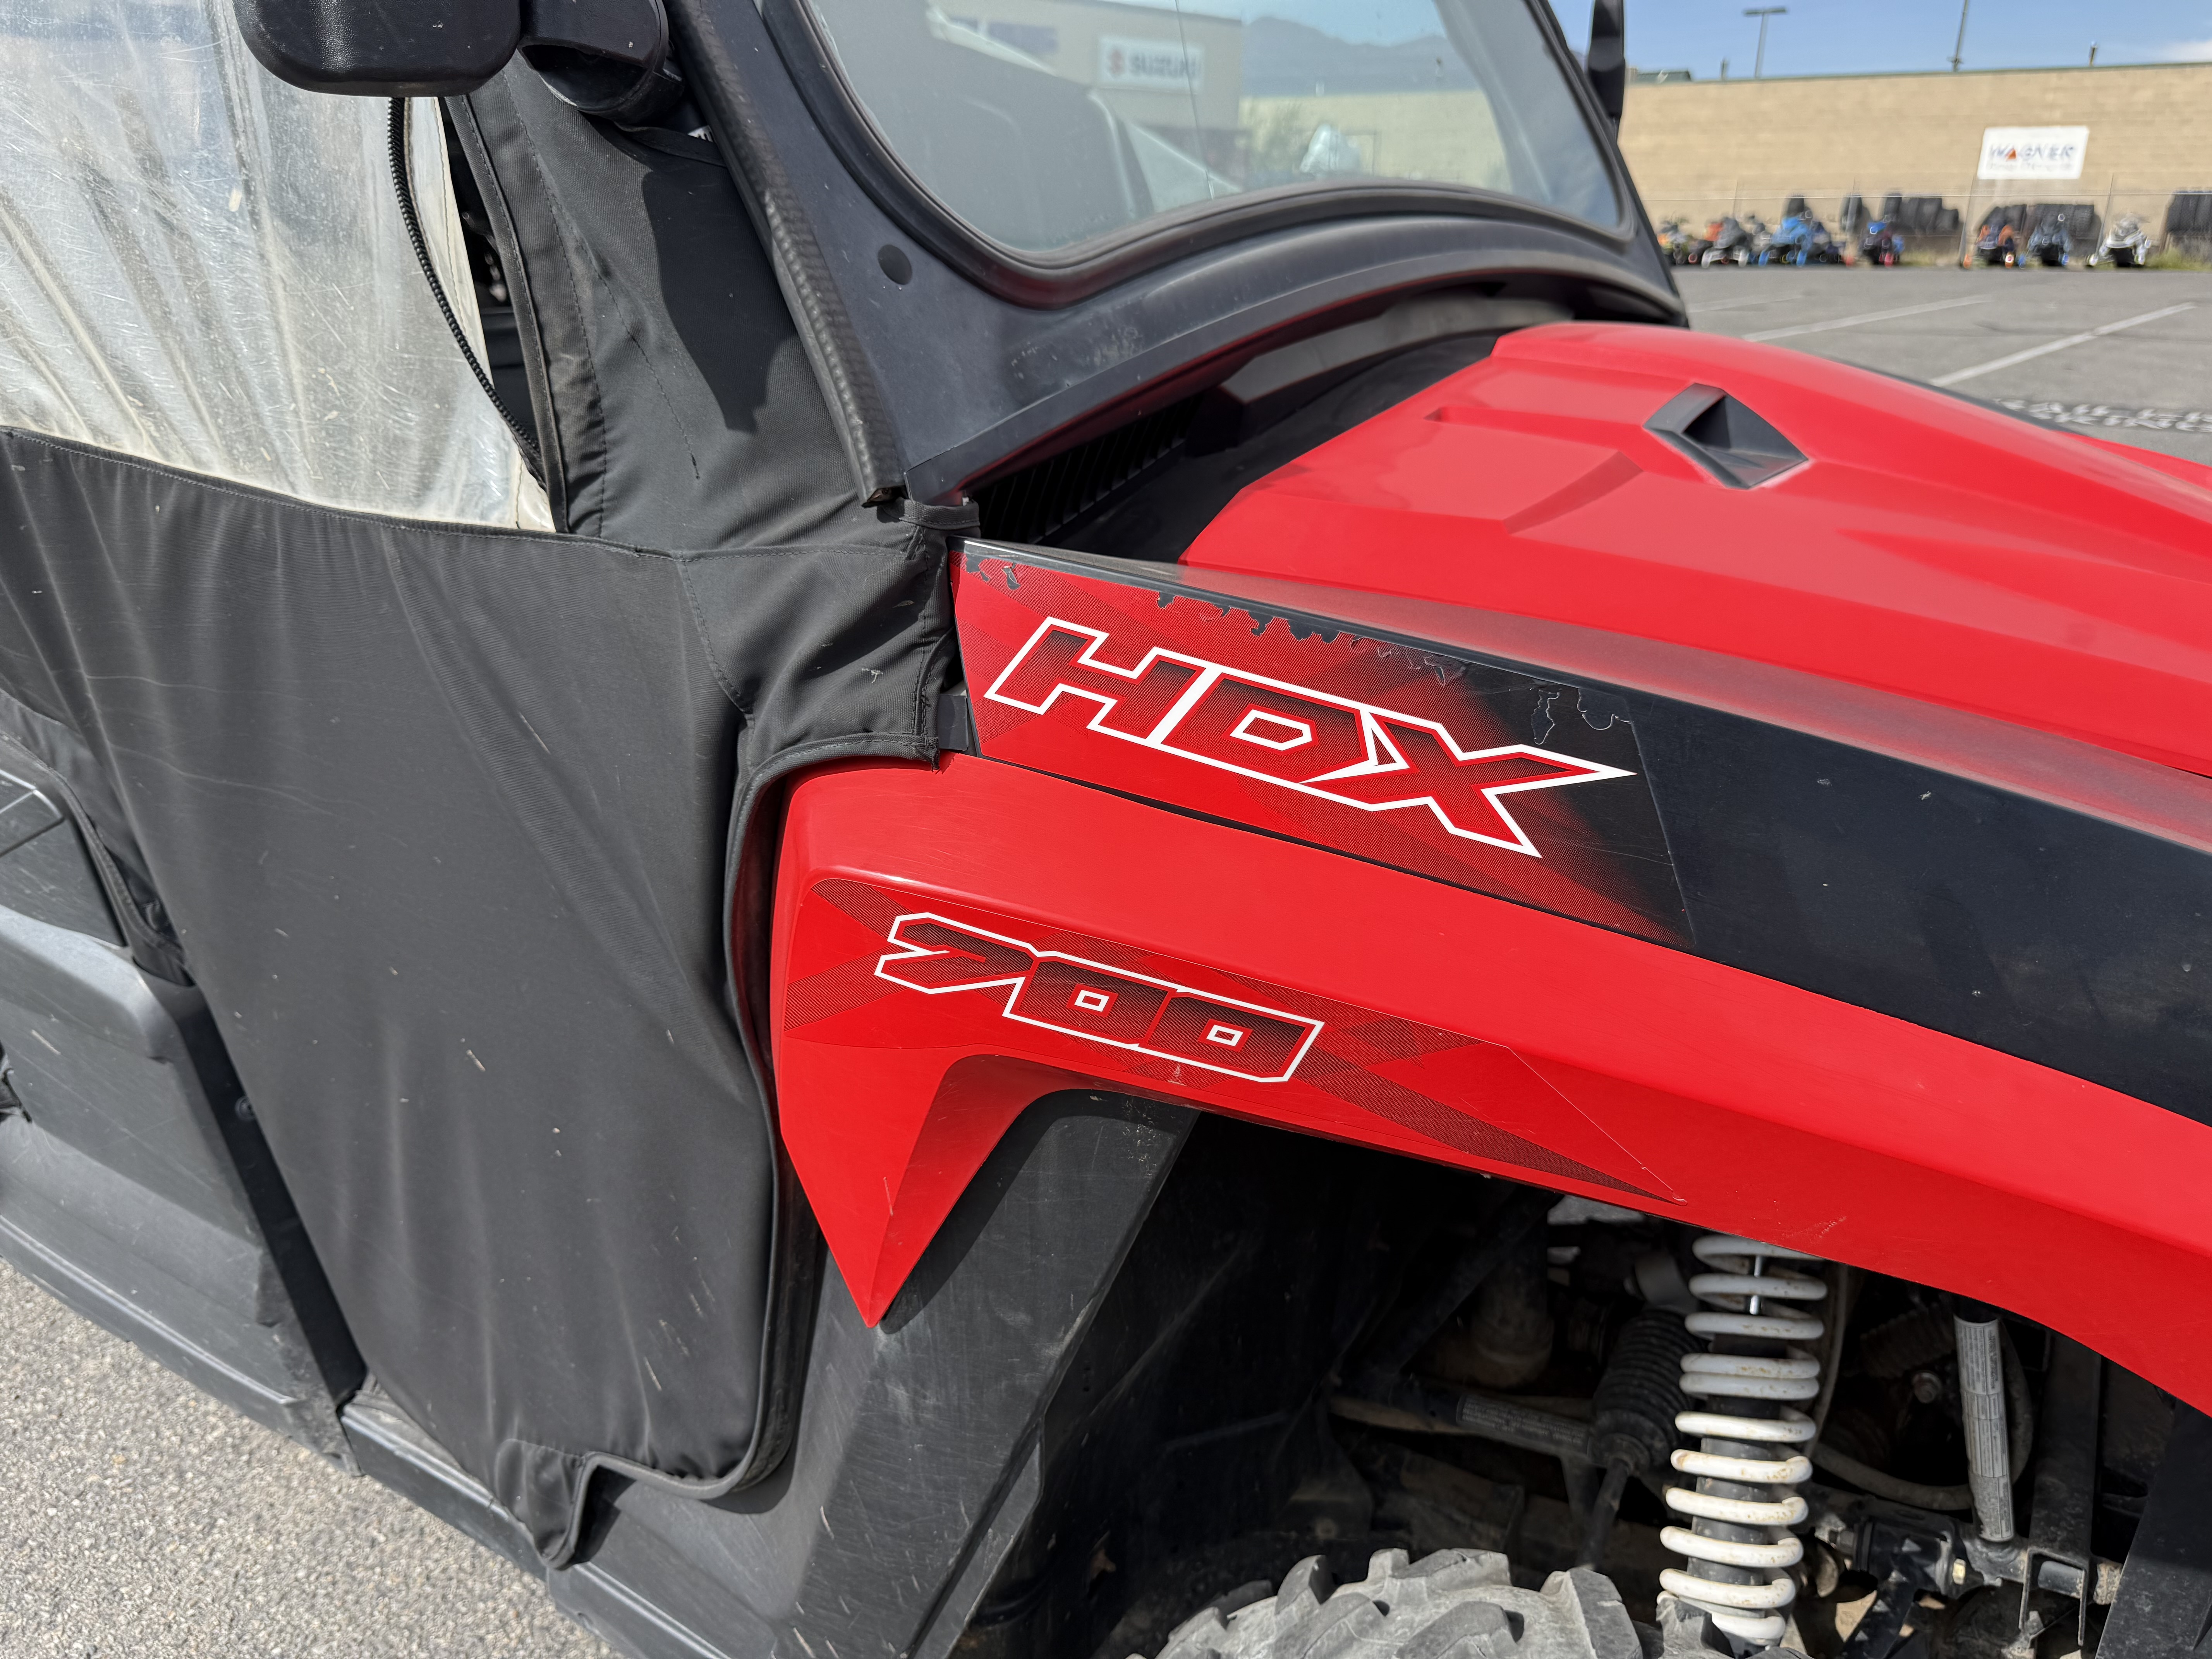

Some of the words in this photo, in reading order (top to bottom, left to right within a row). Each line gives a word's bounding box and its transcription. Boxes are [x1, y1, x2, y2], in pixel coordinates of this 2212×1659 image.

[1130, 54, 1200, 77] SUZUKI
[1990, 144, 2074, 160] WAGNER
[985, 617, 1637, 858] HDX
[874, 912, 1324, 1083] 700
